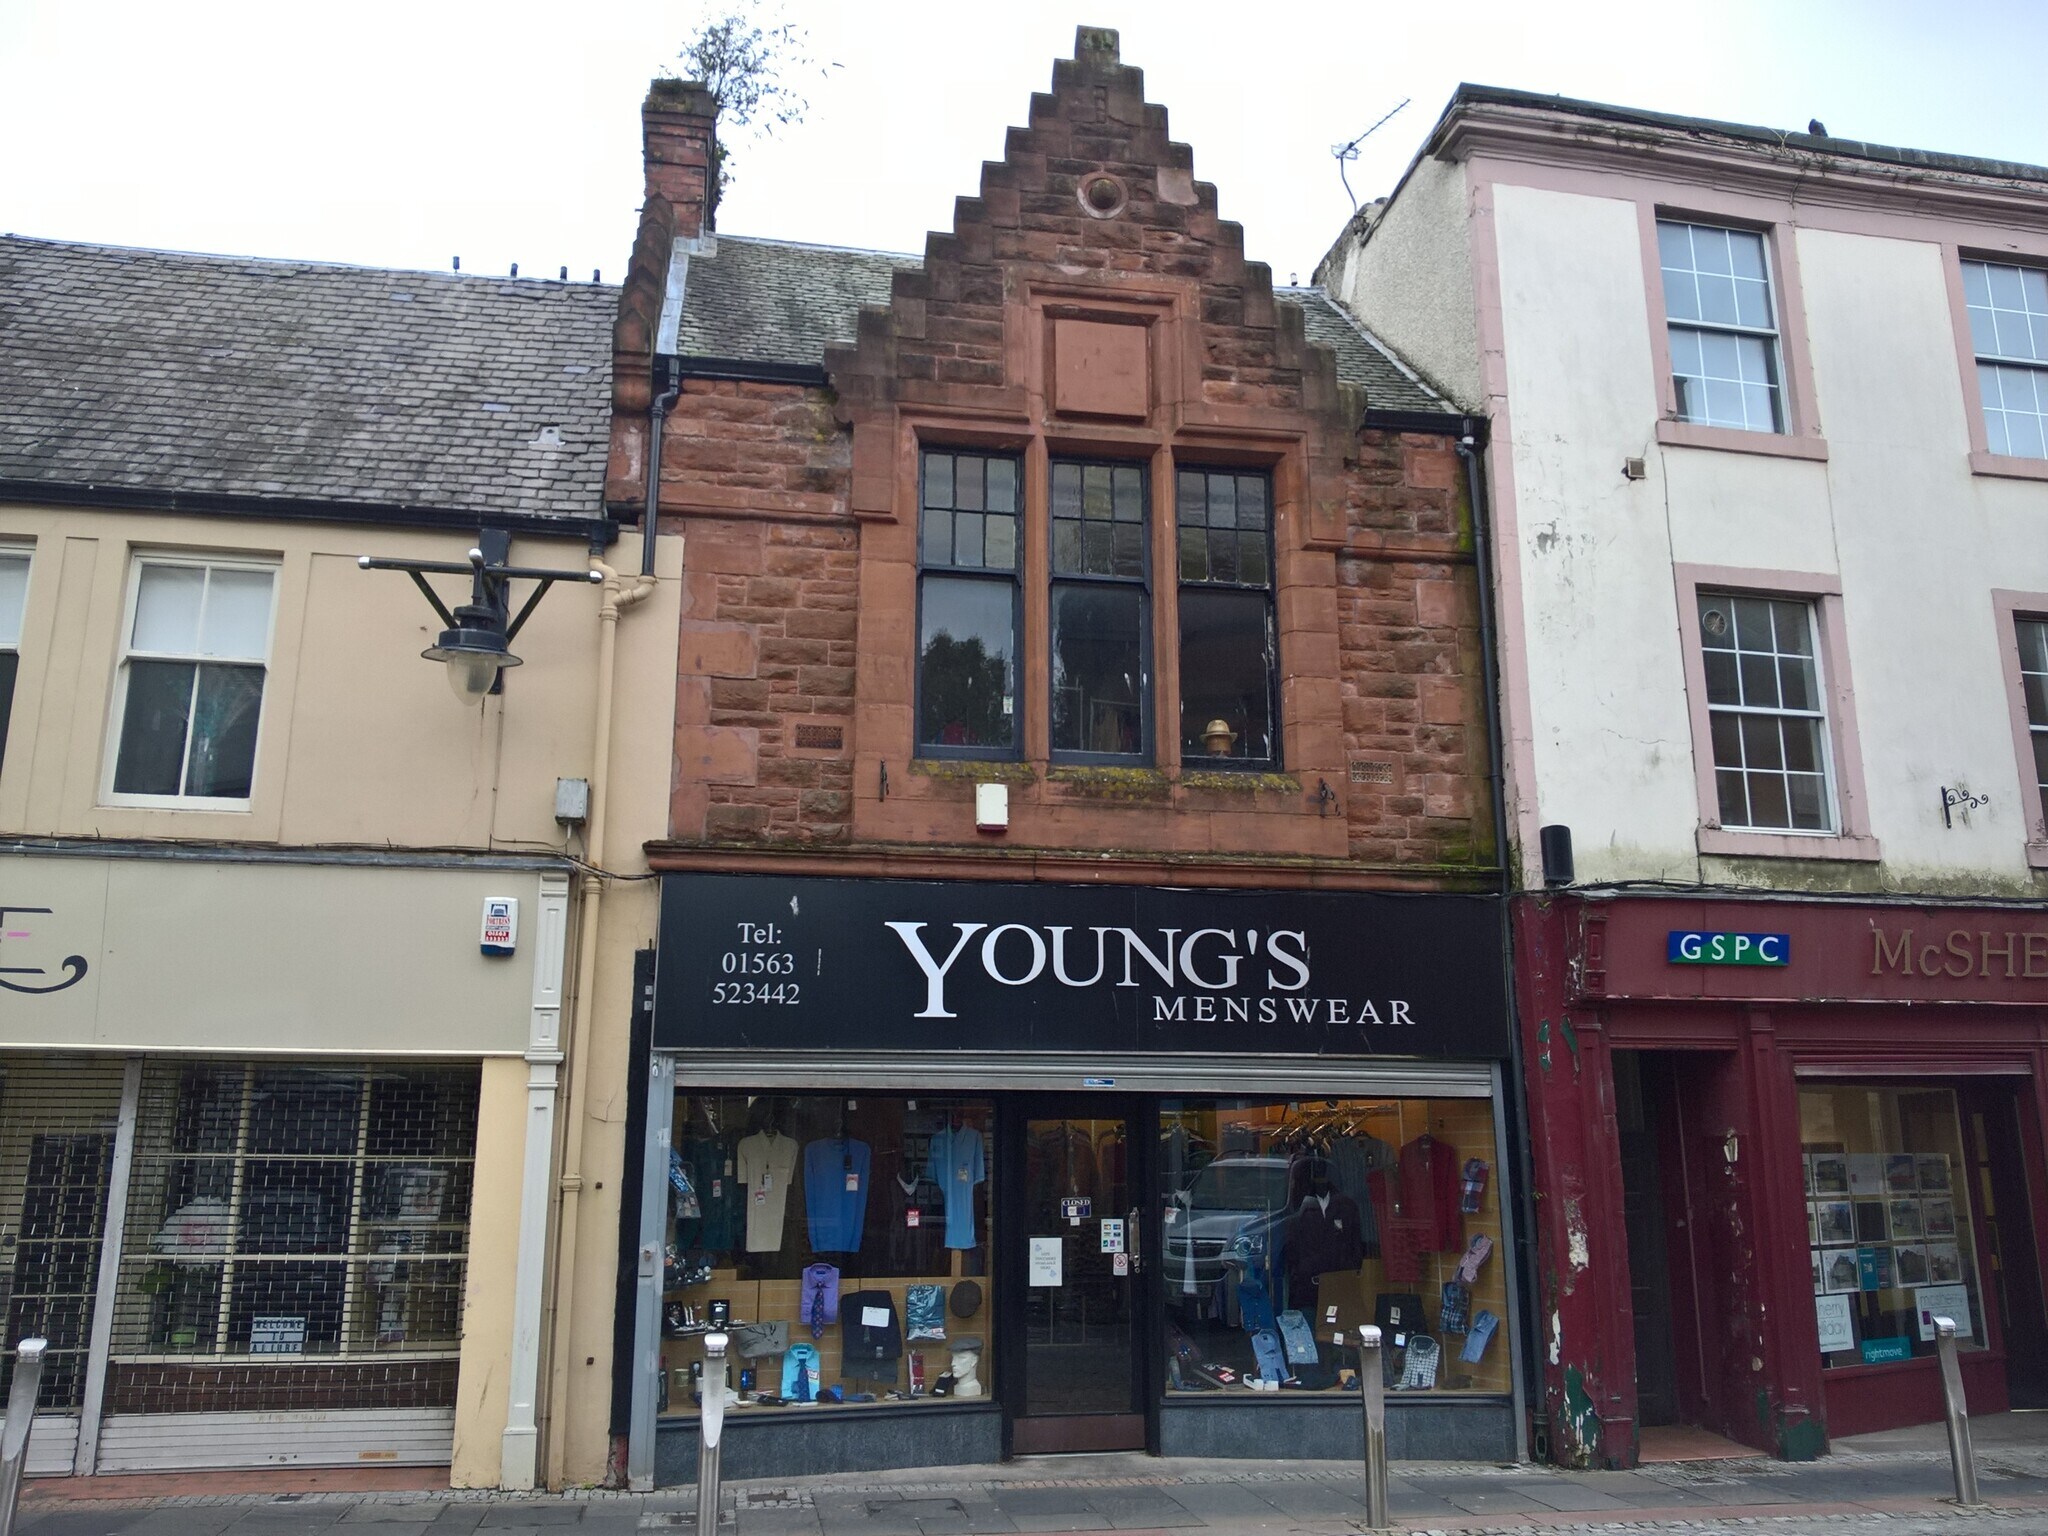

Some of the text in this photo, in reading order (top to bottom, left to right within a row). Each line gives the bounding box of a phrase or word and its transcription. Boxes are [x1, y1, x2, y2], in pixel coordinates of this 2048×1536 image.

[737, 922, 783, 945] Tel:
[1679, 933, 1780, 962] GSPC
[722, 952, 795, 975] 01563
[884, 921, 1311, 1019] YOUNG'S
[712, 981, 801, 1006] 523442
[1153, 994, 1416, 1026] MENSWEAR
[256, 1319, 302, 1329] WELCOME
[272, 1332, 285, 1341] TO
[1865, 1347, 1903, 1362] rightmove
